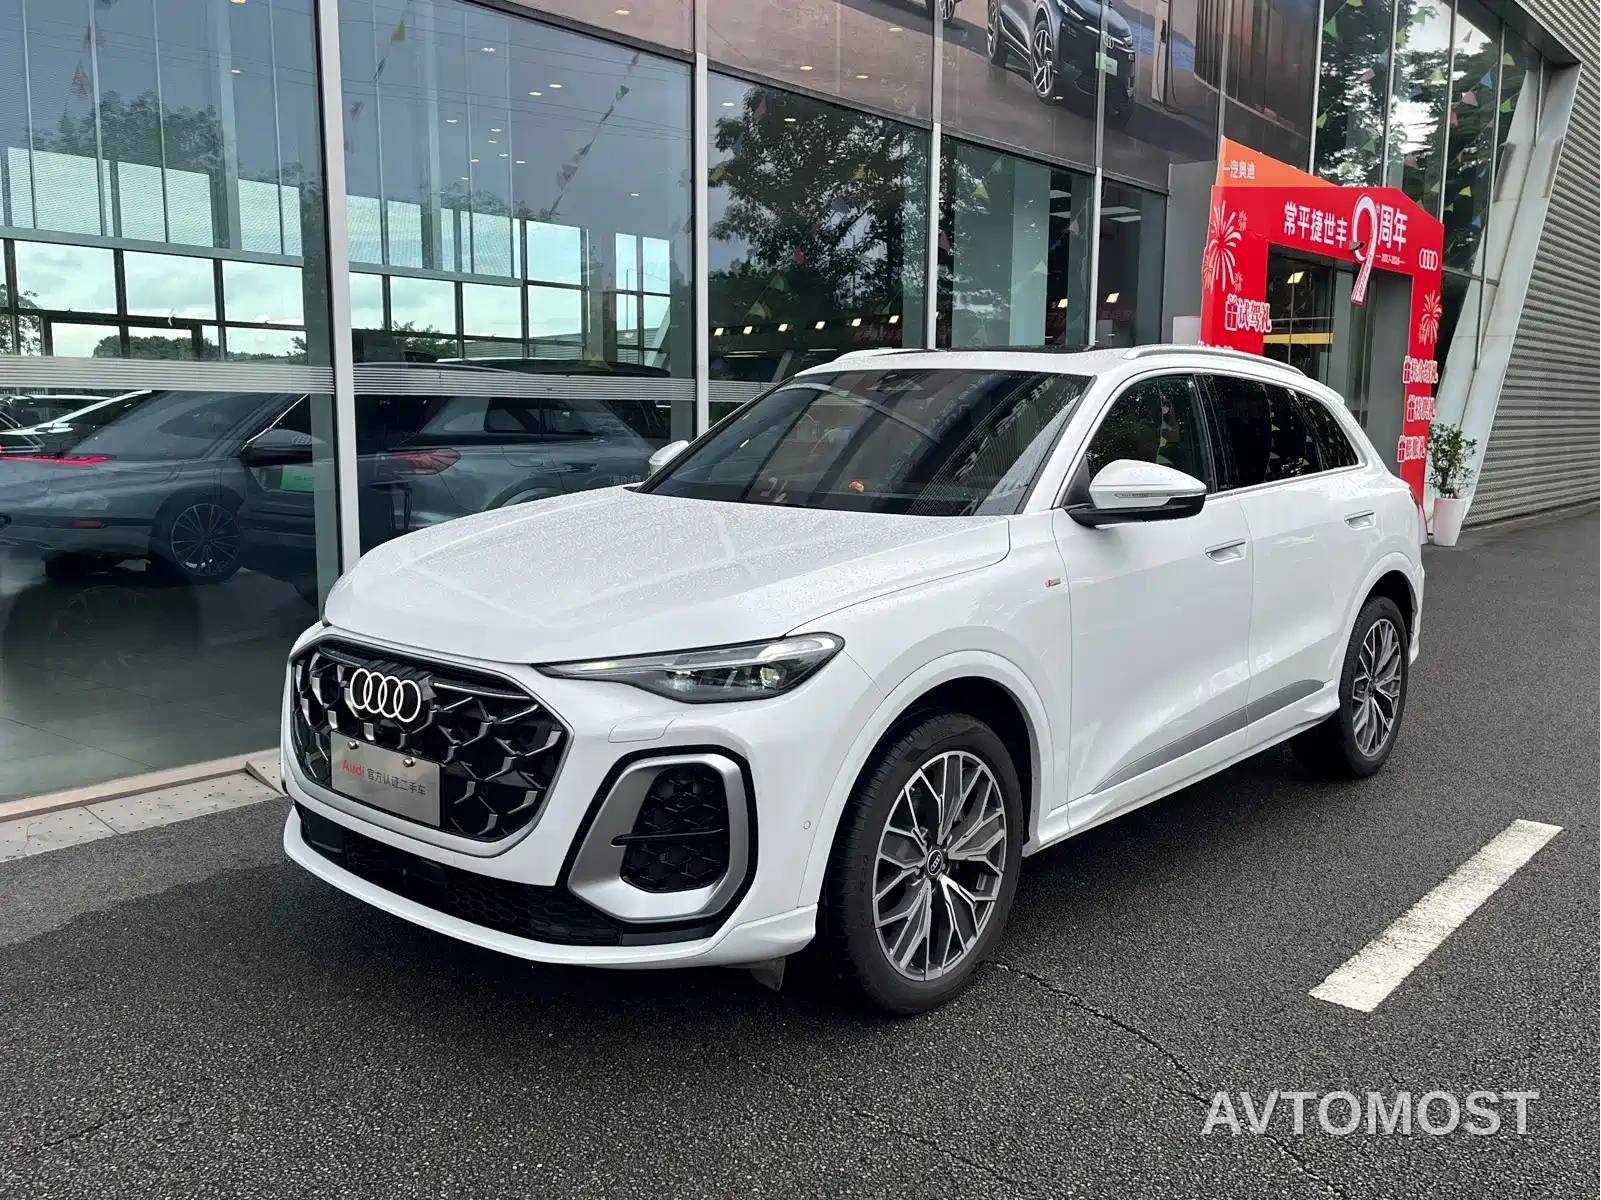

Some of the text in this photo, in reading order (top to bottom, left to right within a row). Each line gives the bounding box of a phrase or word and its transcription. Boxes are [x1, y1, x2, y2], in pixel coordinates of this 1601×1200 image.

[1223, 160, 1255, 179] 一汽奥迪
[1238, 298, 1271, 332] 试驾礼
[342, 759, 426, 796] Audi 官方认证二手车
